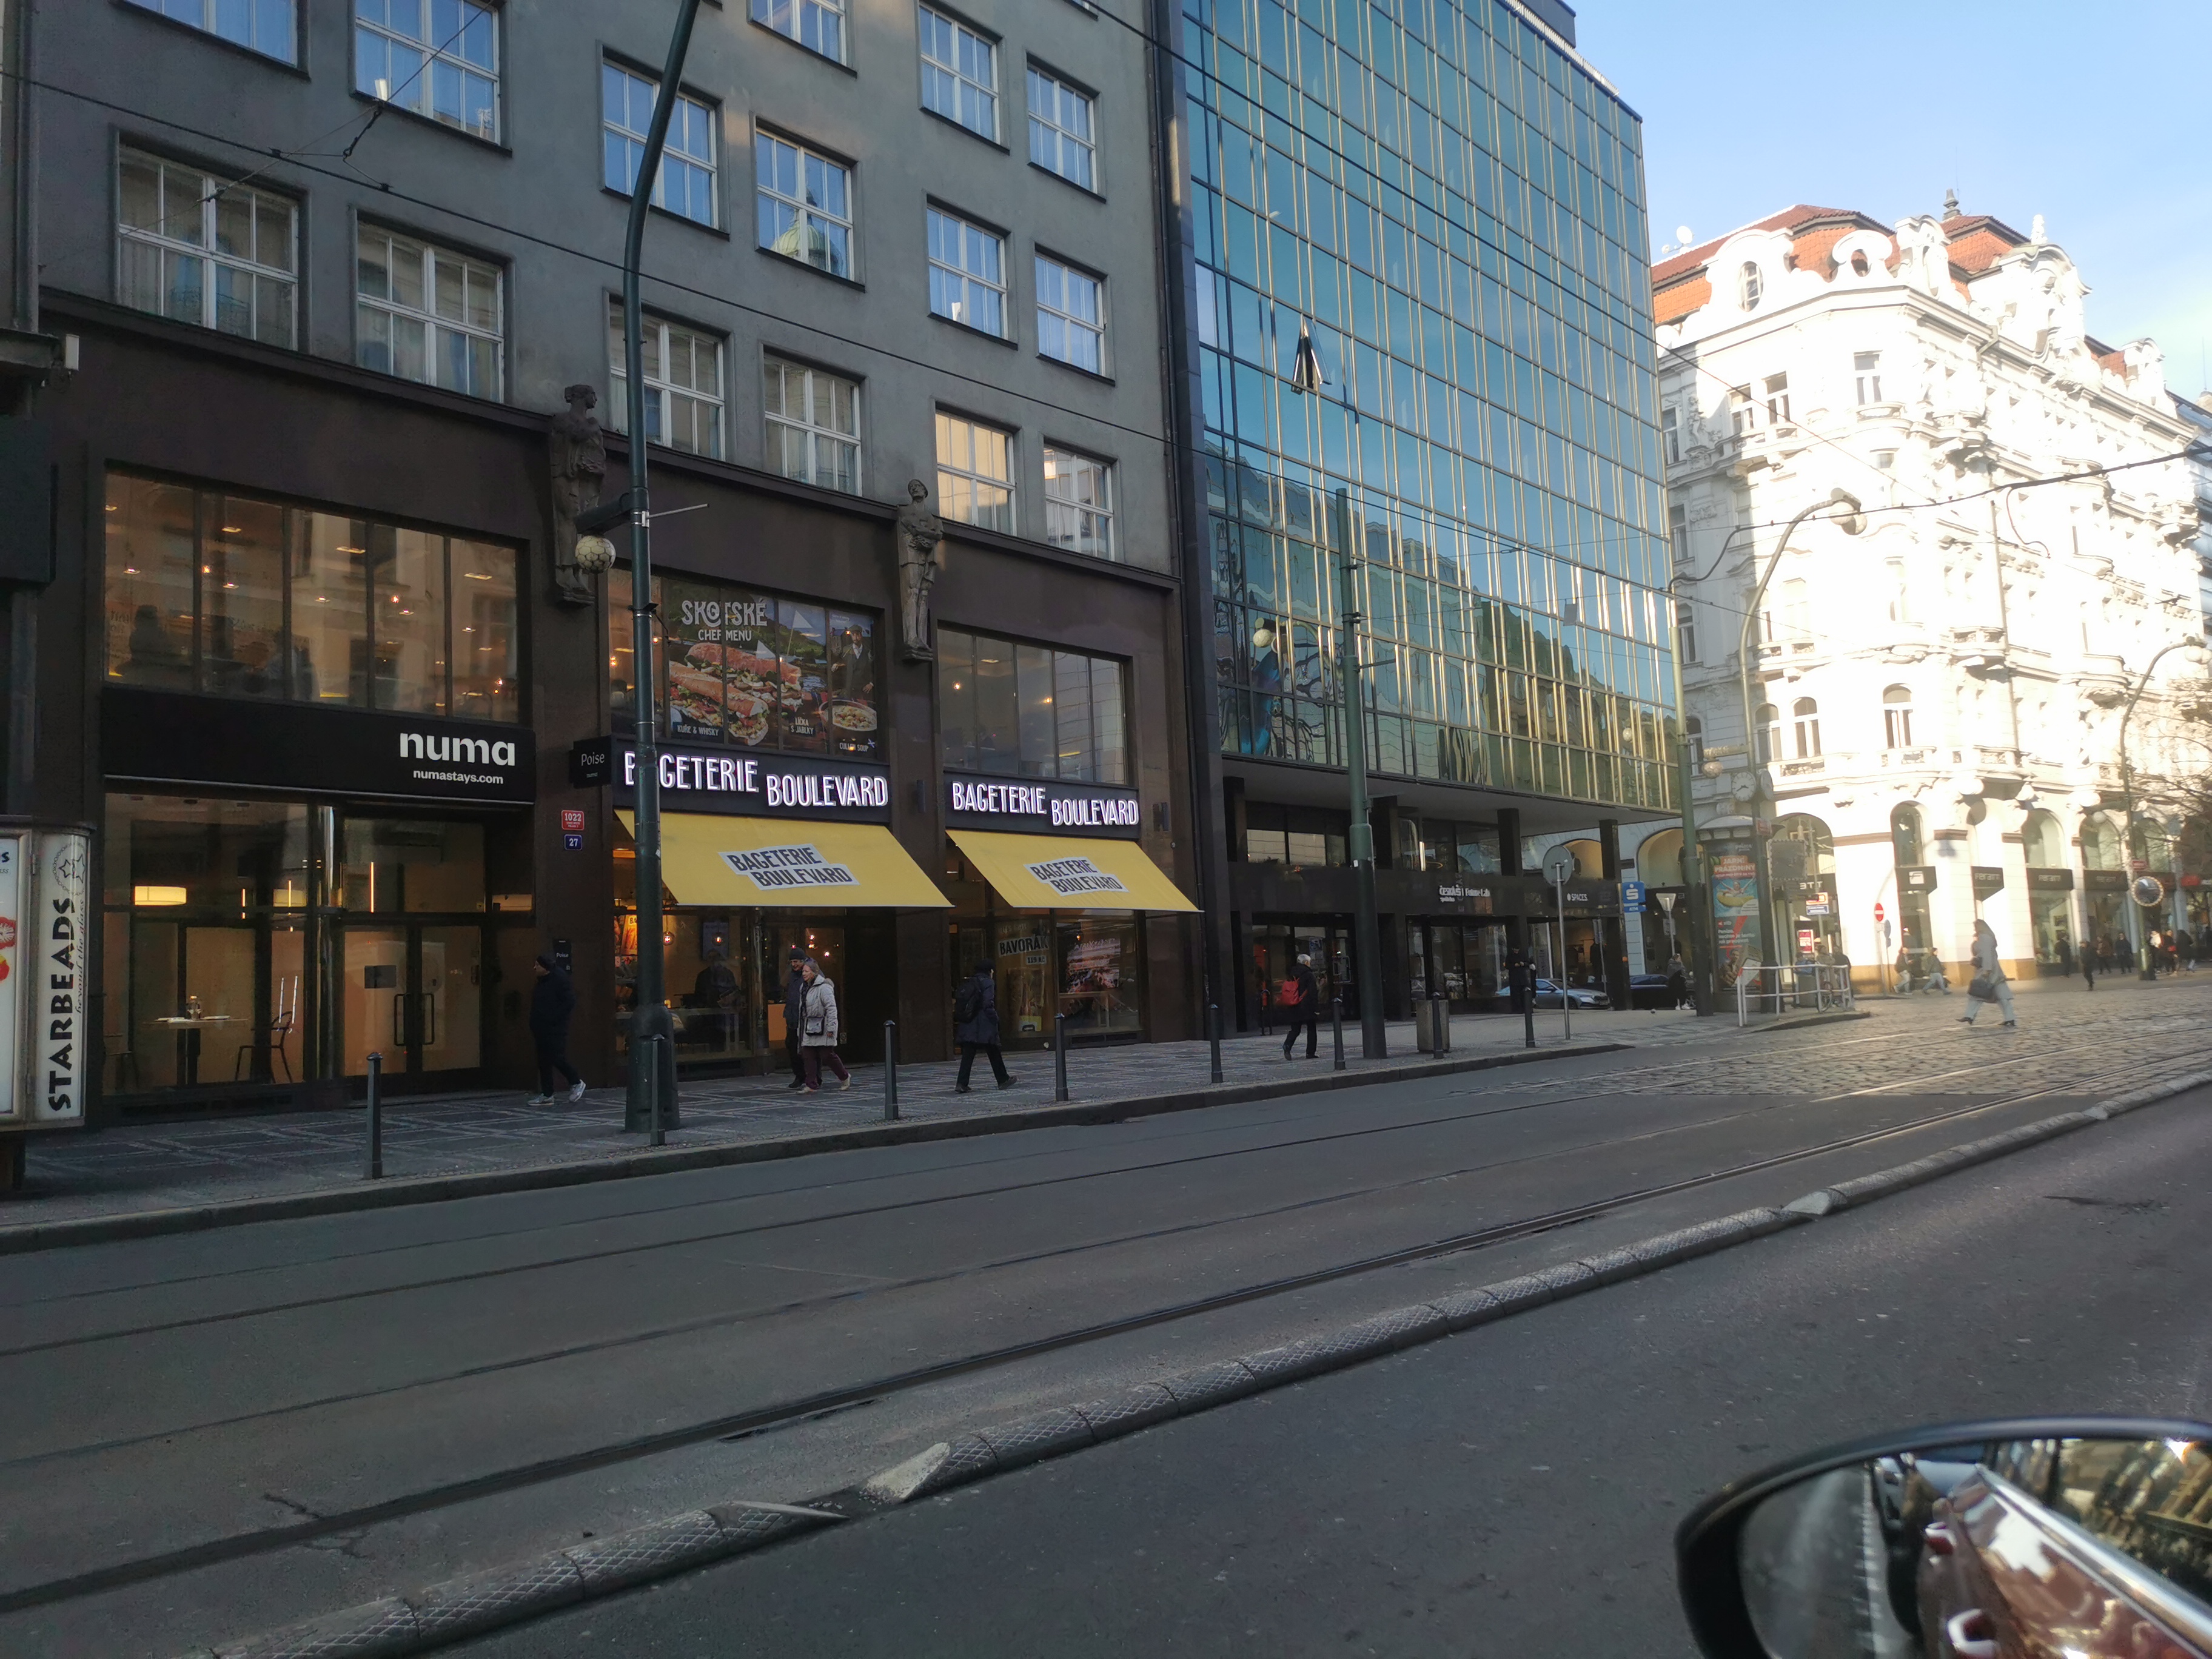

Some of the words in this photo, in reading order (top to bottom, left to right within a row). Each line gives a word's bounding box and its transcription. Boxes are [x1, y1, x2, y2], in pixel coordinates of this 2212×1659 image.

[698, 629, 722, 641] CHEF
[726, 630, 752, 642] MENU
[699, 727, 719, 736] WHISKY
[400, 732, 515, 766] numa
[581, 751, 605, 766] Poise
[413, 770, 504, 784] numastays.com
[624, 751, 759, 793] BGETERIE
[766, 774, 889, 807] BOULEVARD
[953, 781, 1047, 814] BAGETERIE
[1051, 798, 1139, 826] BOULEVARD
[565, 813, 582, 822] 1022
[569, 838, 578, 847] 27
[726, 848, 822, 871] BAGETERIE
[751, 868, 853, 886] BOULEVARD
[1030, 859, 1098, 880] BAGETERIE
[1050, 876, 1122, 893] BOULEVARD
[48, 898, 75, 1111] STARBEADS
